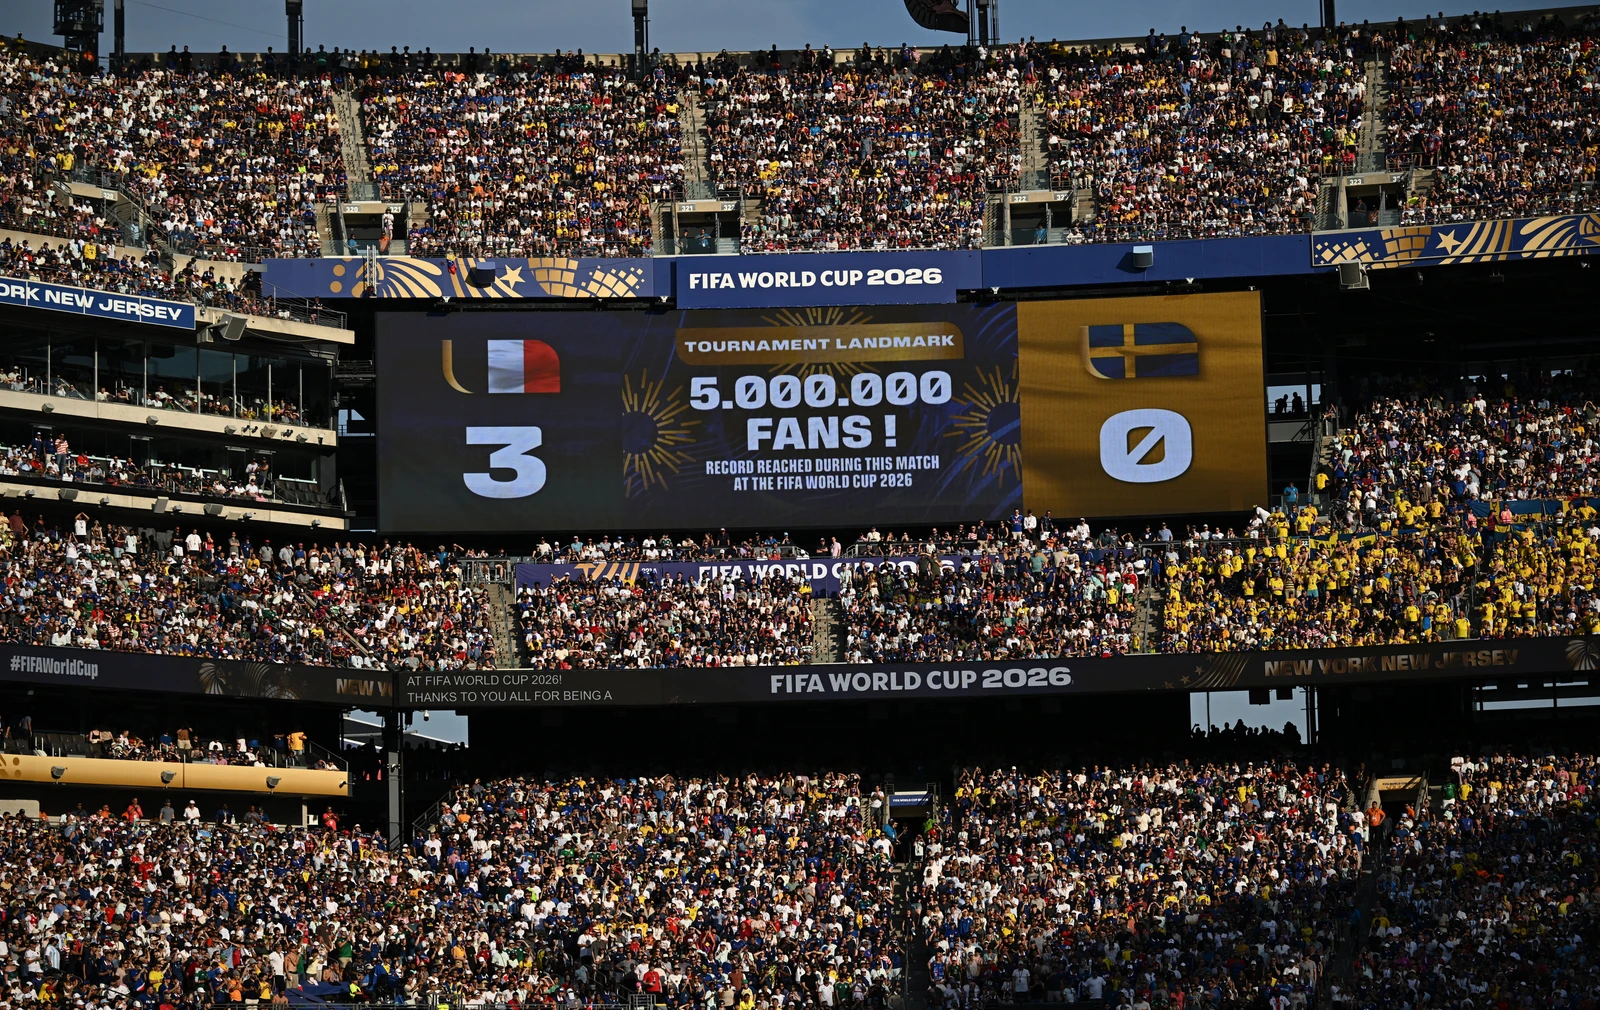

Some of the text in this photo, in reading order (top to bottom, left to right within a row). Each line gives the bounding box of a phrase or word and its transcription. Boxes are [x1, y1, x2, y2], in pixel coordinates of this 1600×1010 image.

[1350, 178, 1362, 186] 323
[689, 268, 942, 289] FIFA WORLD CUP 2026
[45, 290, 94, 308] NEW
[99, 299, 182, 321] JERSEY
[684, 335, 954, 352] TOURNAMENT LANDMARK
[690, 370, 952, 410] 5.000.000
[747, 415, 897, 450] FANS !
[463, 426, 546, 498] 3
[706, 455, 939, 474] RECORD REACHED DURING THIS MATCH
[734, 473, 912, 491] AT THE FIFA WORLD CUP 2026
[10, 655, 98, 680] #FIFAWorldCup
[1264, 649, 1519, 676] NEW YORK NEW JERSEY
[336, 678, 374, 696] NEW
[407, 674, 562, 686] AT FIFA WORLD CUP 2026!
[771, 667, 1071, 693] FIFA WORLD CUP 2026
[408, 690, 612, 702] THANKS TO YOU ALL FOR BEING A
